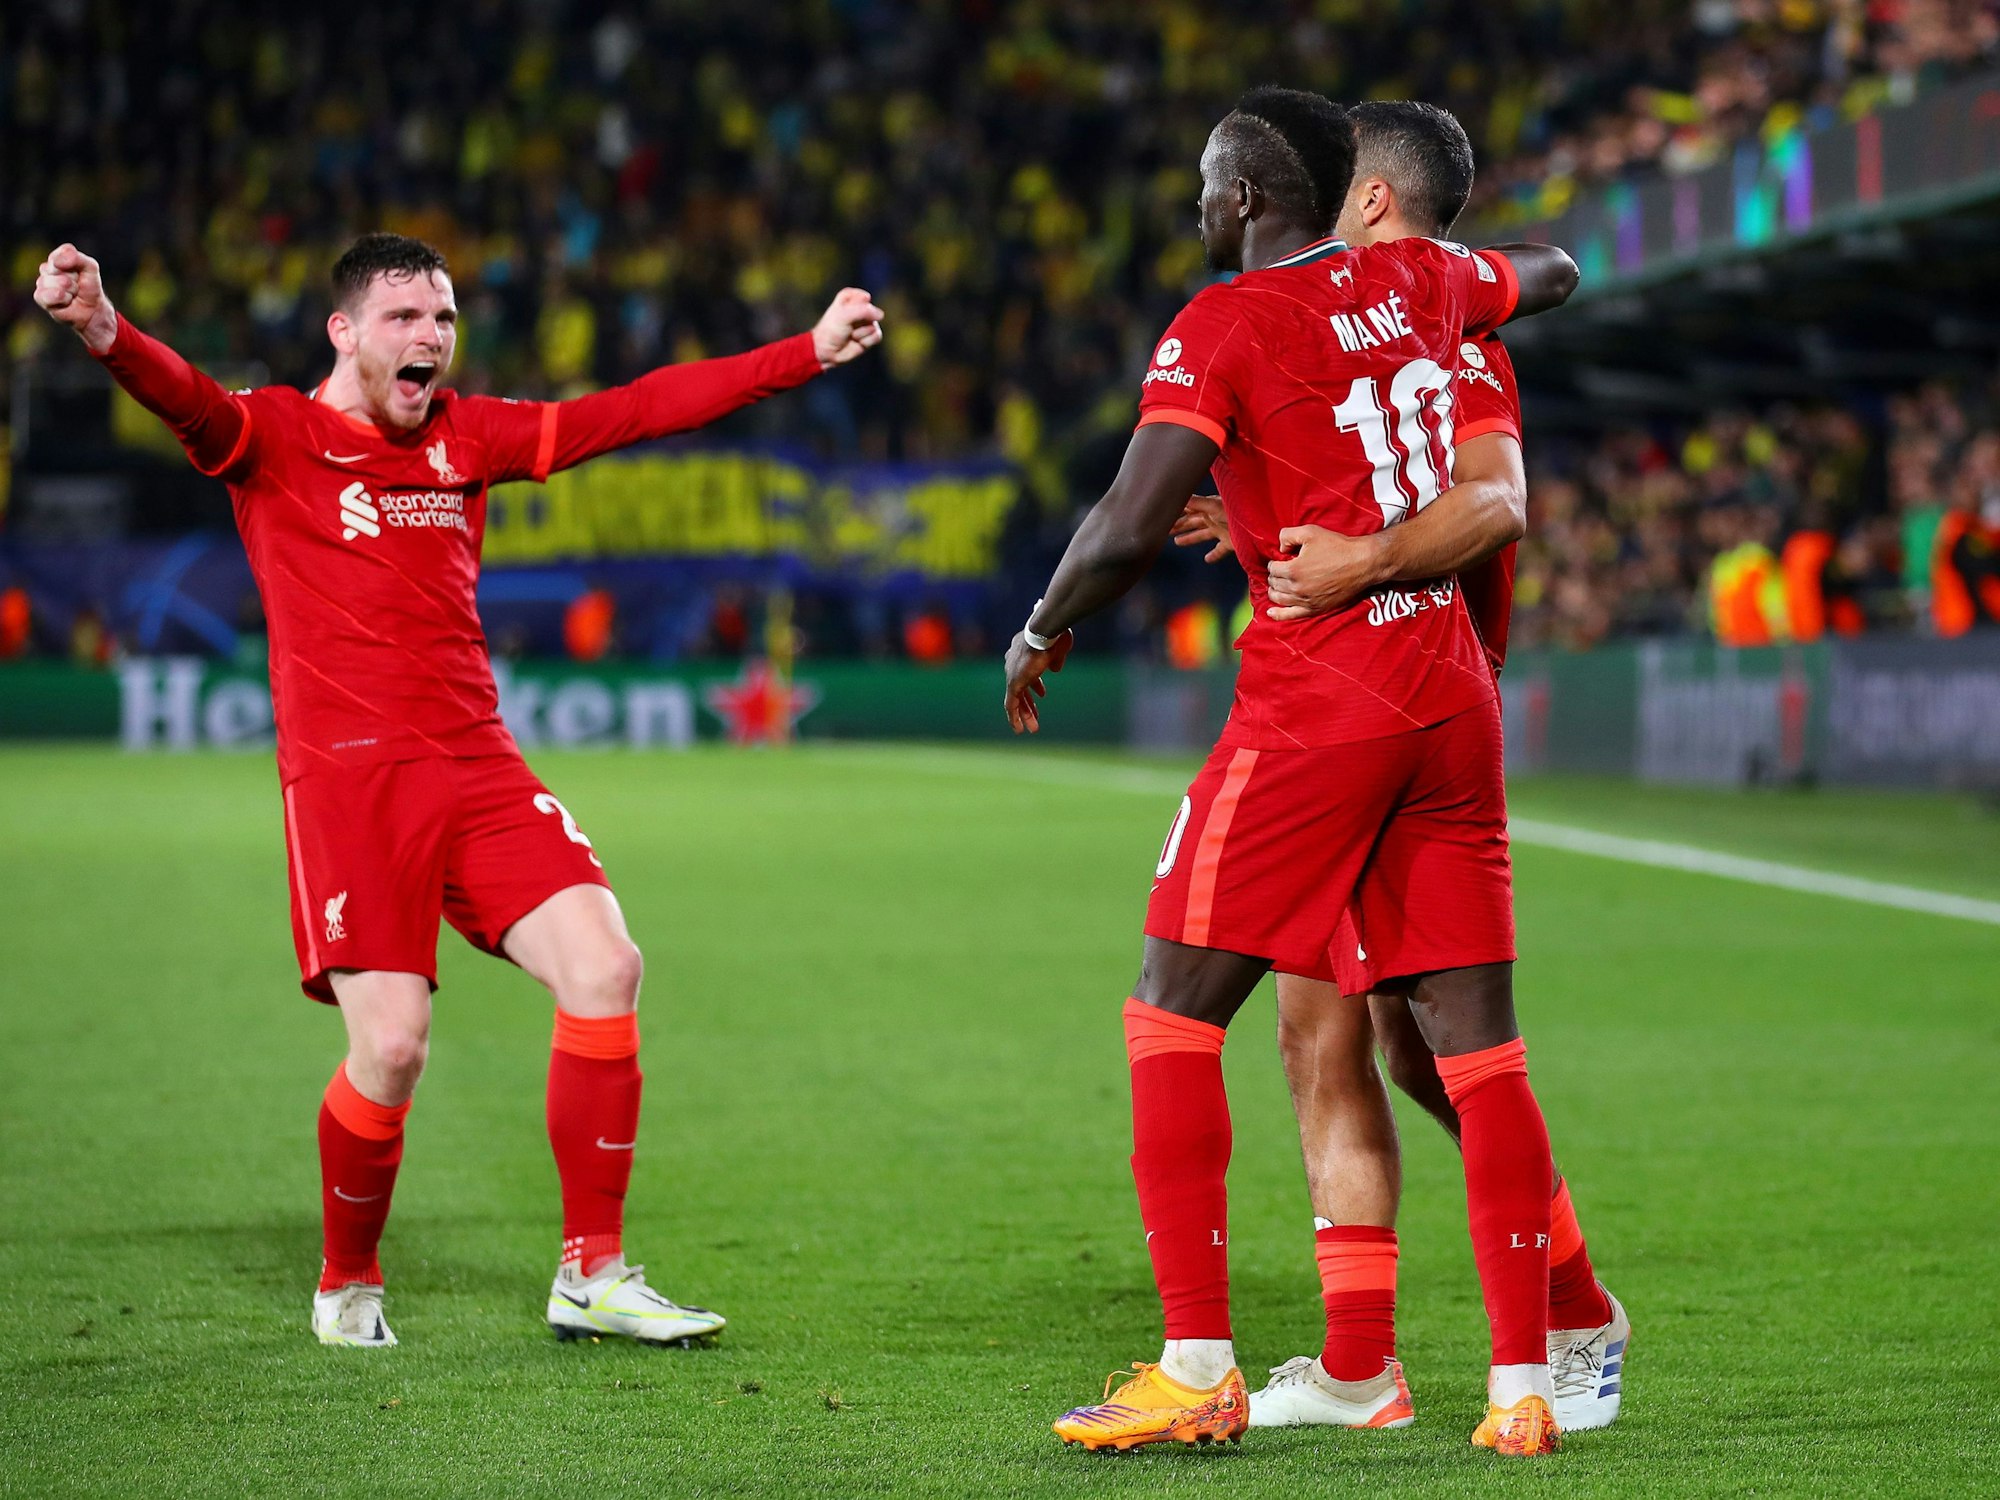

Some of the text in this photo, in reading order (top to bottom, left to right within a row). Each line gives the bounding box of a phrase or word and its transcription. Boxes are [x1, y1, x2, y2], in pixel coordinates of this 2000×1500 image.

[1330, 290, 1412, 352] MANÉ
[1141, 366, 1196, 387] xpedia
[1458, 368, 1503, 393] xpedia
[1332, 358, 1456, 528] 10
[379, 490, 464, 513] standard
[120, 655, 696, 752] Heken
[1211, 1229, 1228, 1246] L
[1510, 1233, 1551, 1250] LF
